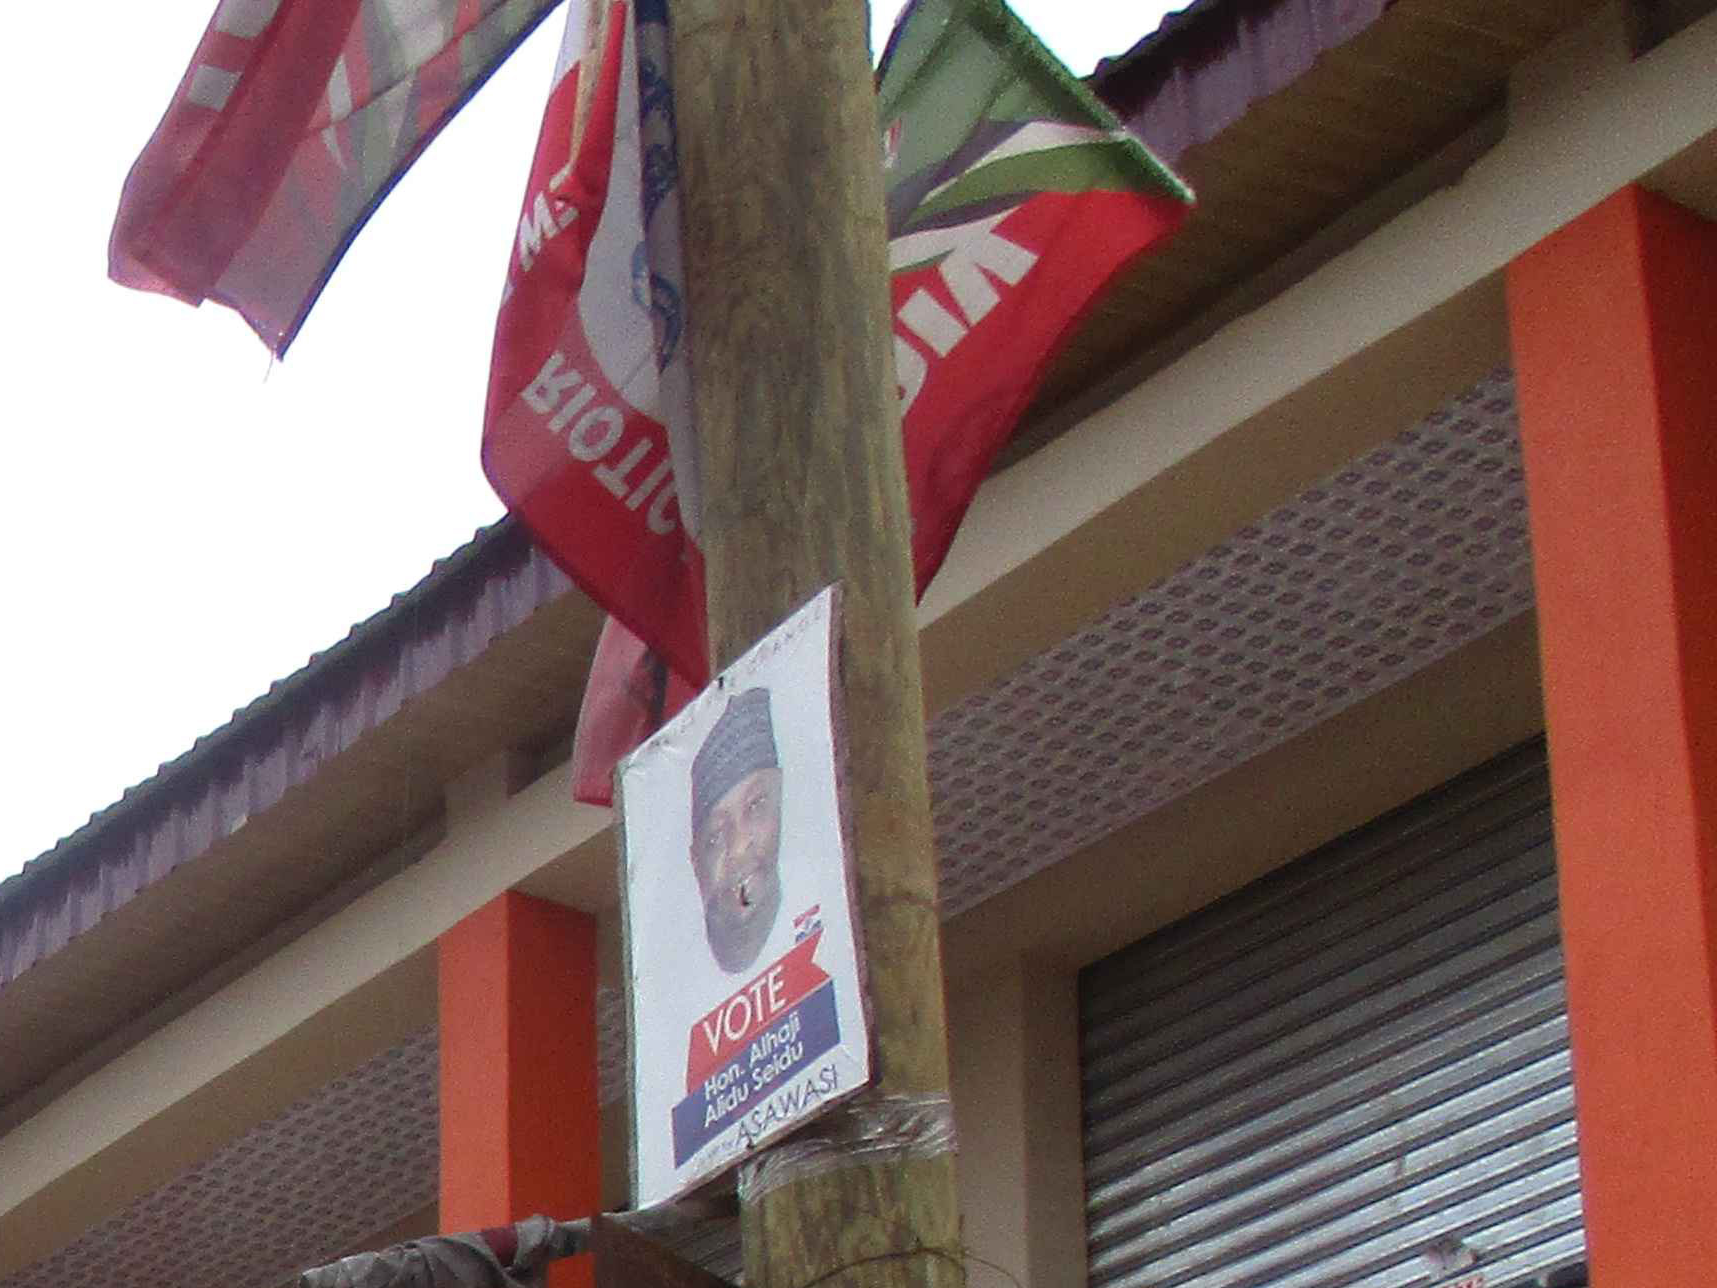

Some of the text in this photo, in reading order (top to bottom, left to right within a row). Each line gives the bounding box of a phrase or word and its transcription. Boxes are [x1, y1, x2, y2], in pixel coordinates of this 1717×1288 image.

[702, 964, 786, 1056] VOTE
[703, 1041, 804, 1128] Alidu Seidu
[704, 1010, 802, 1101] Hon. Alhaji
[737, 1064, 838, 1144] ASAWASI
